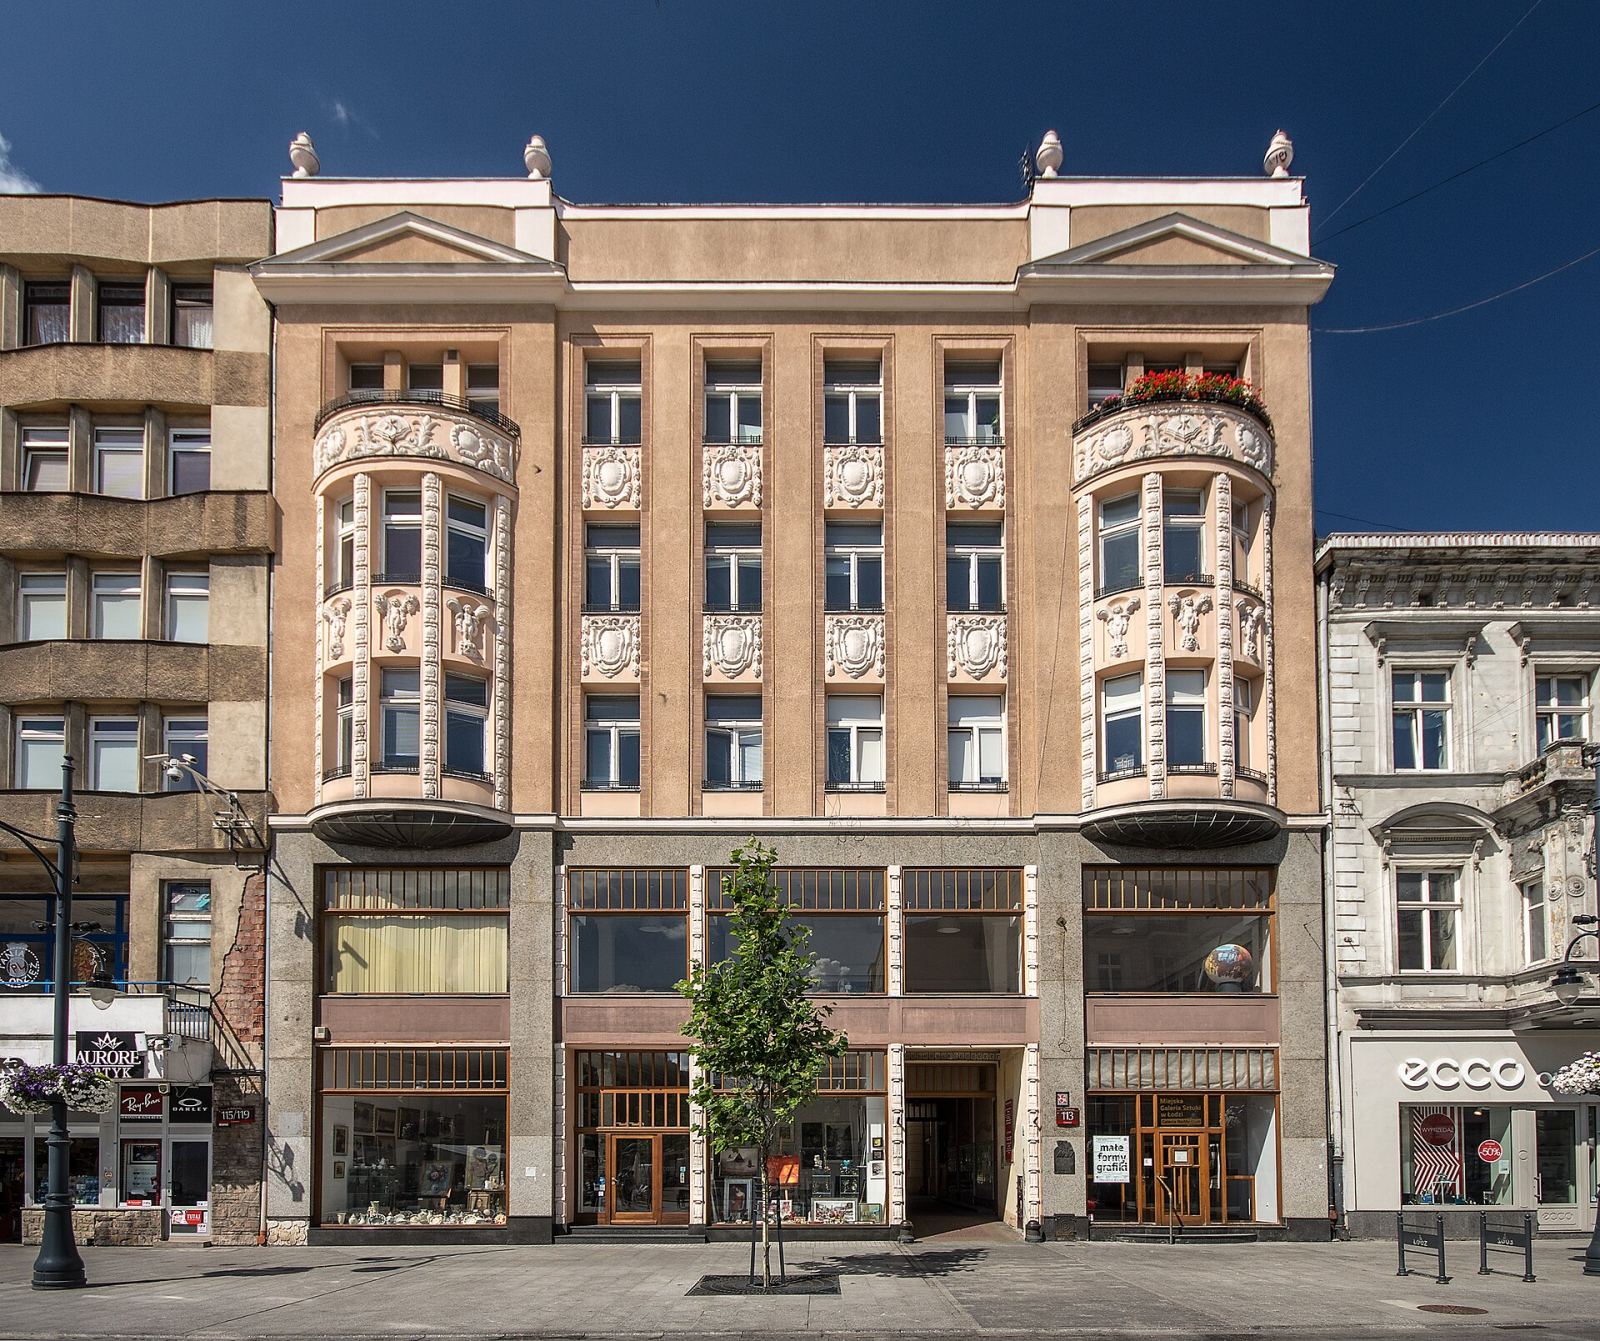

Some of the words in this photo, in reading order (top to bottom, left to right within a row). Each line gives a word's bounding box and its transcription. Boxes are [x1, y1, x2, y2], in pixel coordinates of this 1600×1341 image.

[76, 1050, 141, 1065] AURORE
[1398, 1057, 1526, 1089] ecco
[122, 1093, 160, 1112] Ray-Ban
[221, 1110, 250, 1120] 115/119
[1061, 1111, 1074, 1120] 113
[1097, 1153, 1127, 1164] formy
[1096, 1163, 1128, 1173] grafiki
